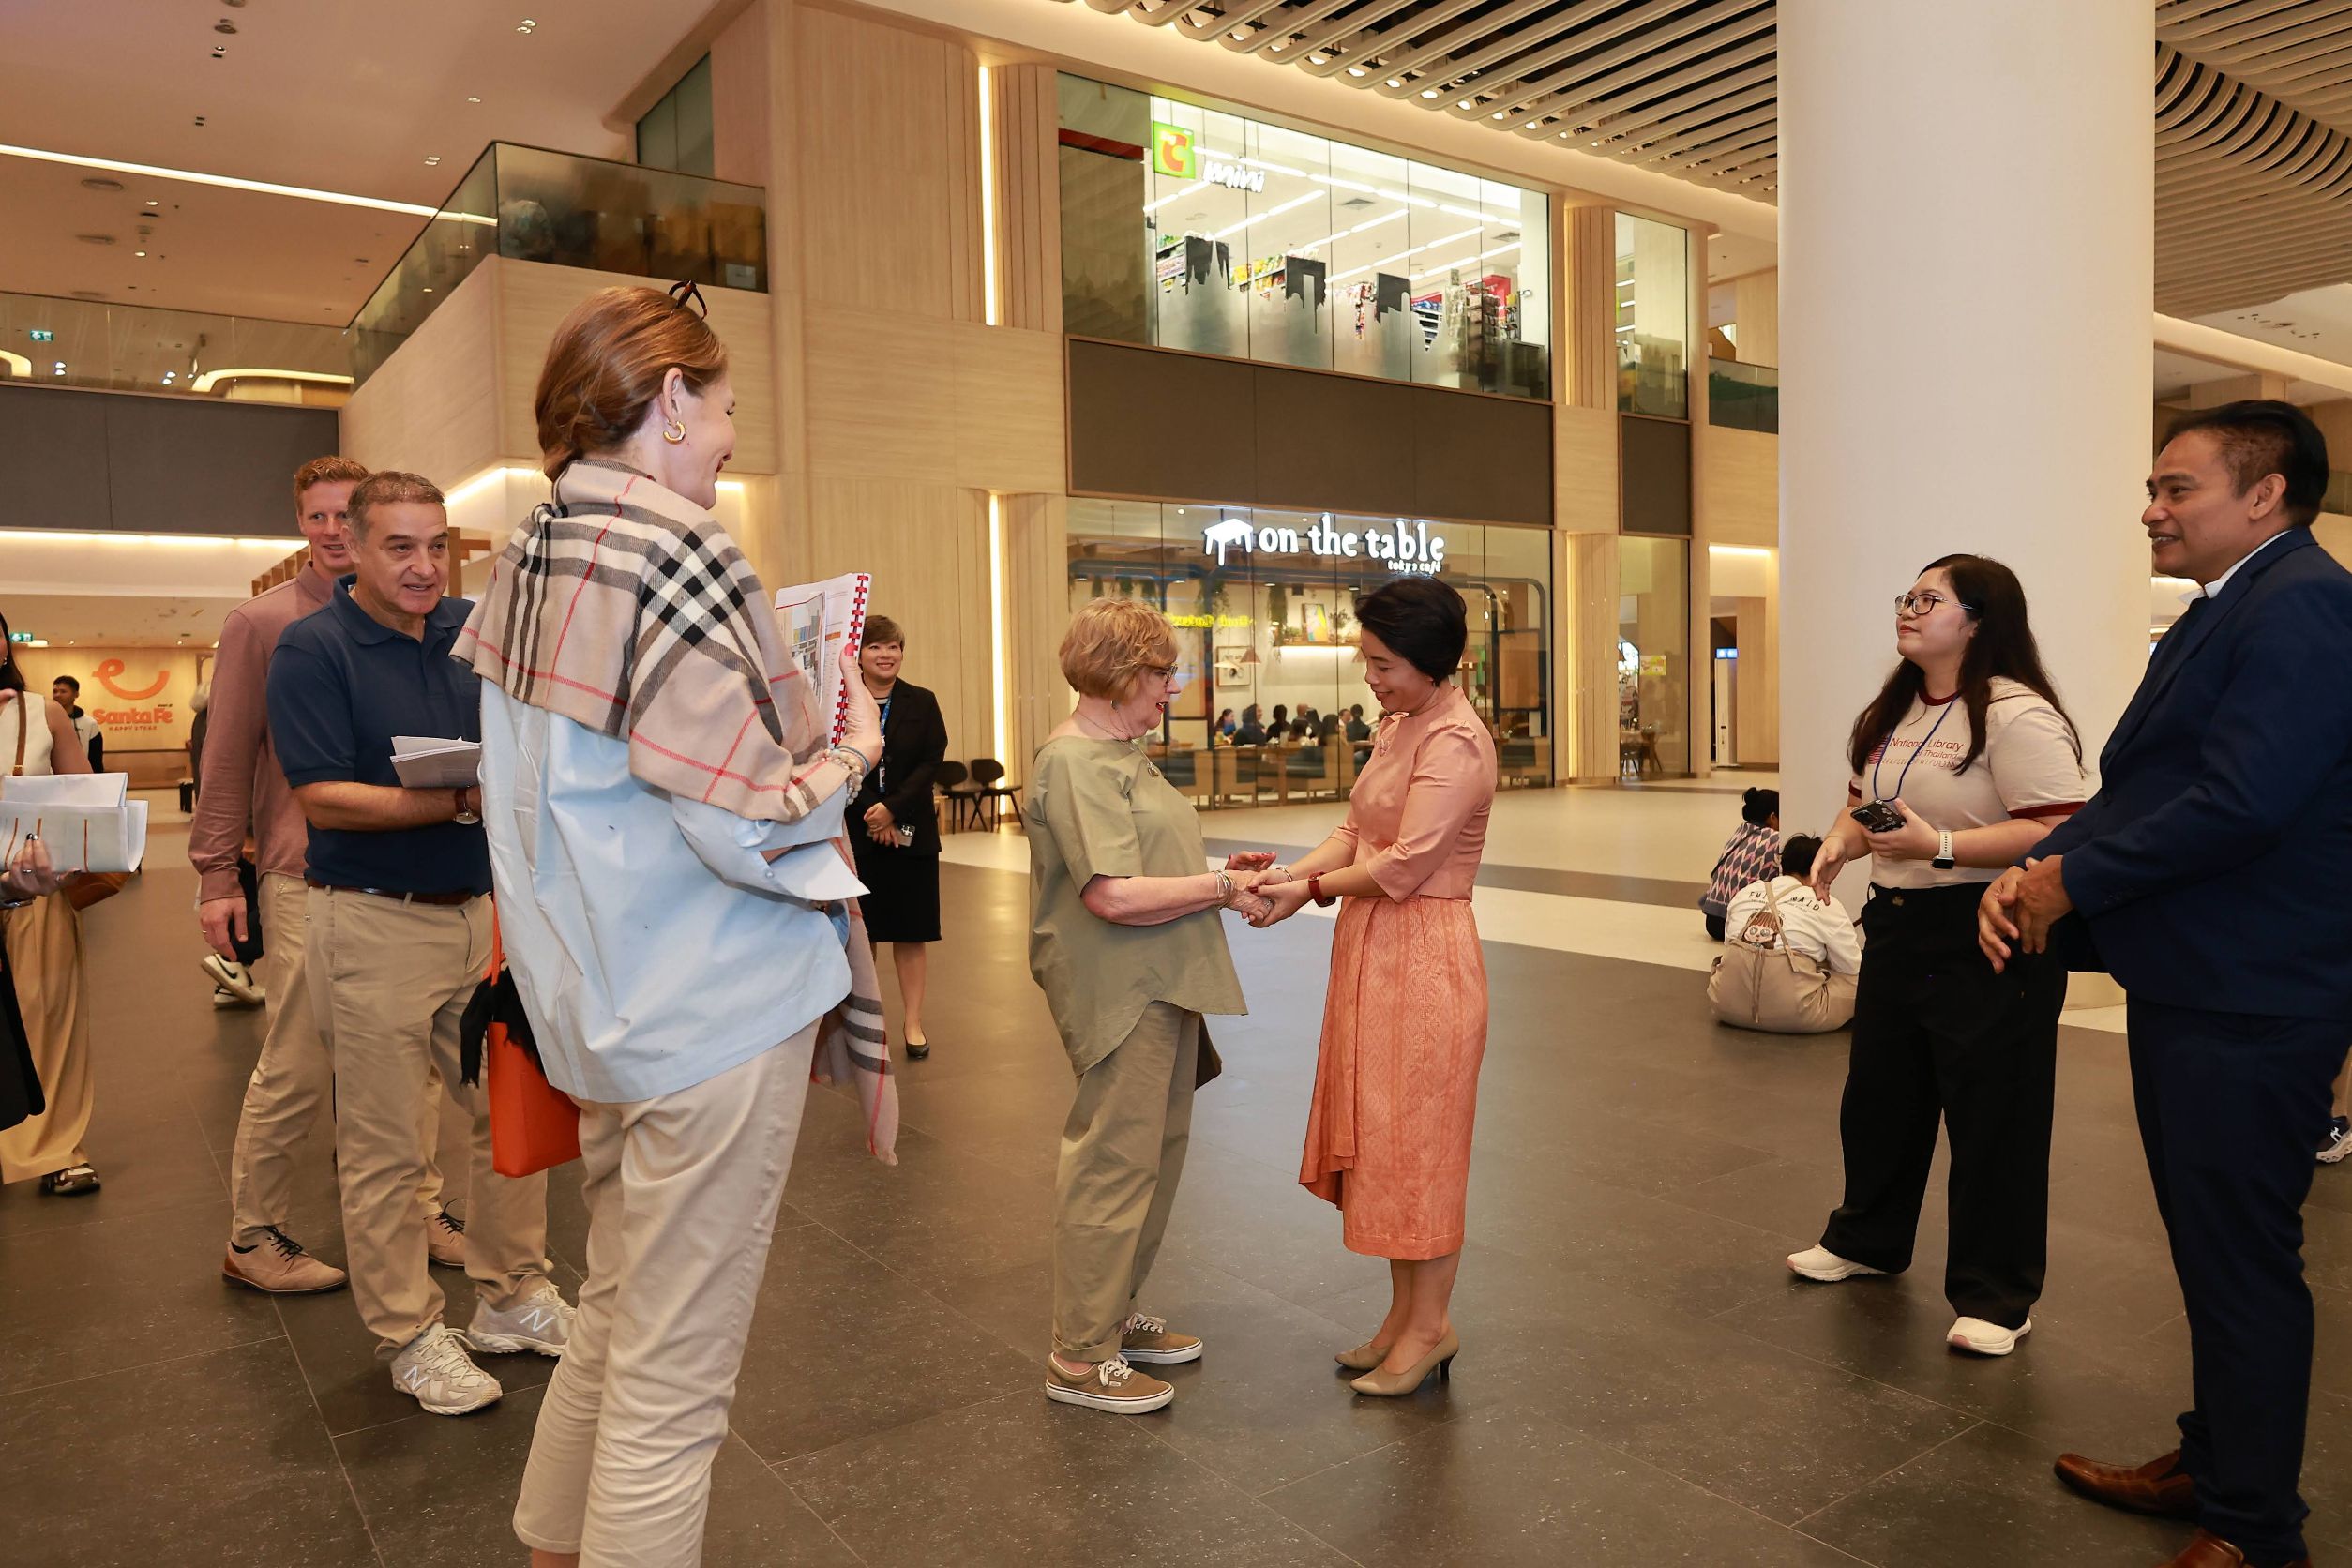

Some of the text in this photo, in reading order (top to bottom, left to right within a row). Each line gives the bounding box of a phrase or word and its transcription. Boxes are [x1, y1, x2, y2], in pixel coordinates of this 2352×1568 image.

[1259, 514, 1445, 561] on the table
[1927, 739, 1964, 752] Library
[1924, 750, 1958, 760] Thailand
